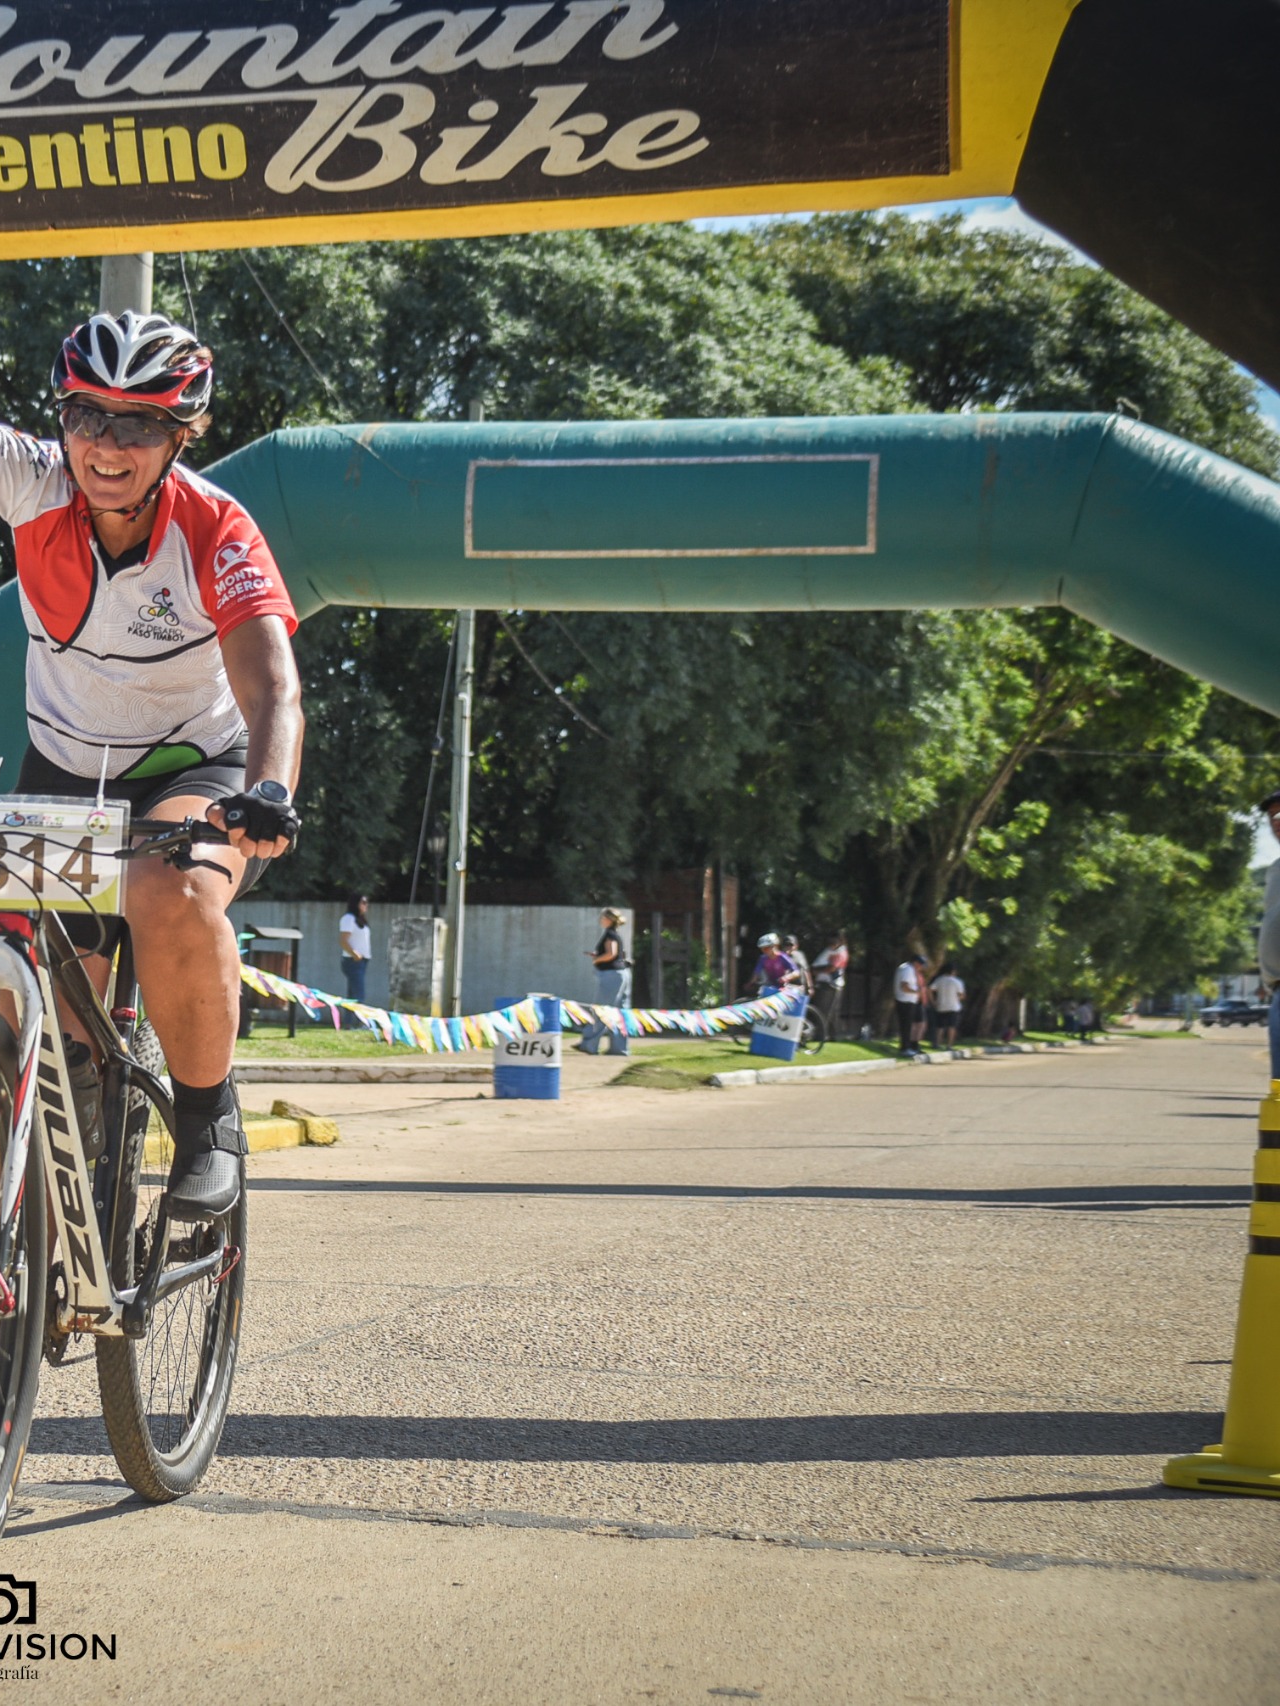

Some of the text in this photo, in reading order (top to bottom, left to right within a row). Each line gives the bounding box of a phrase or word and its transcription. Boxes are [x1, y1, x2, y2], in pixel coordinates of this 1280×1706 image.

[264, 82, 710, 194] Bike
[214, 566, 263, 596] MONTE
[216, 577, 275, 611] CASEROS
[127, 626, 186, 642] PASO TIMBOY
[505, 1040, 541, 1056] elf
